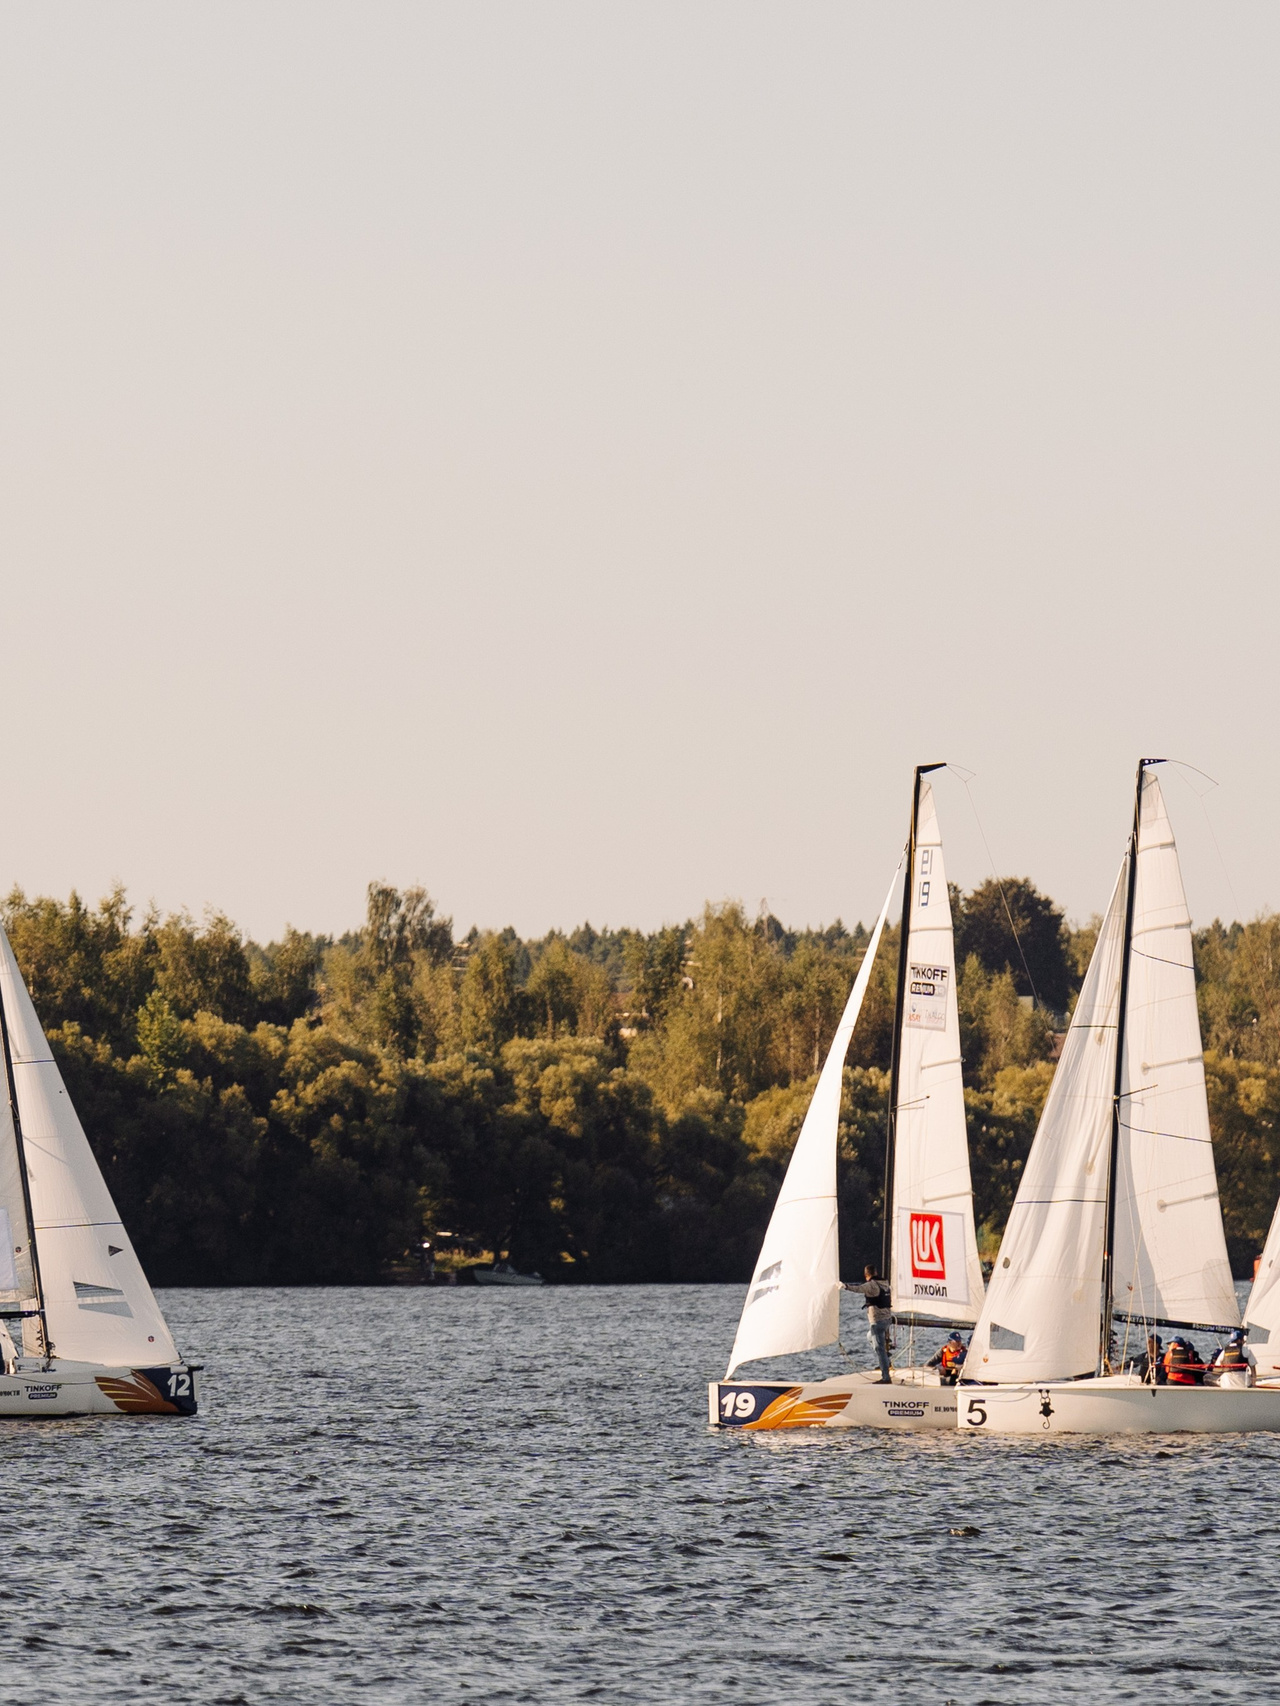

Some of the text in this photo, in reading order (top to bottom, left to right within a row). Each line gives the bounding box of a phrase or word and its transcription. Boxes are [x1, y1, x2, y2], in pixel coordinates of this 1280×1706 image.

[918, 881, 930, 907] 19
[914, 1283, 947, 1297] ЛУКОЙЛ
[167, 1373, 190, 1397] 12
[721, 1392, 756, 1418] 19
[882, 1401, 929, 1409] TINKOFF
[966, 1399, 987, 1426] 5
